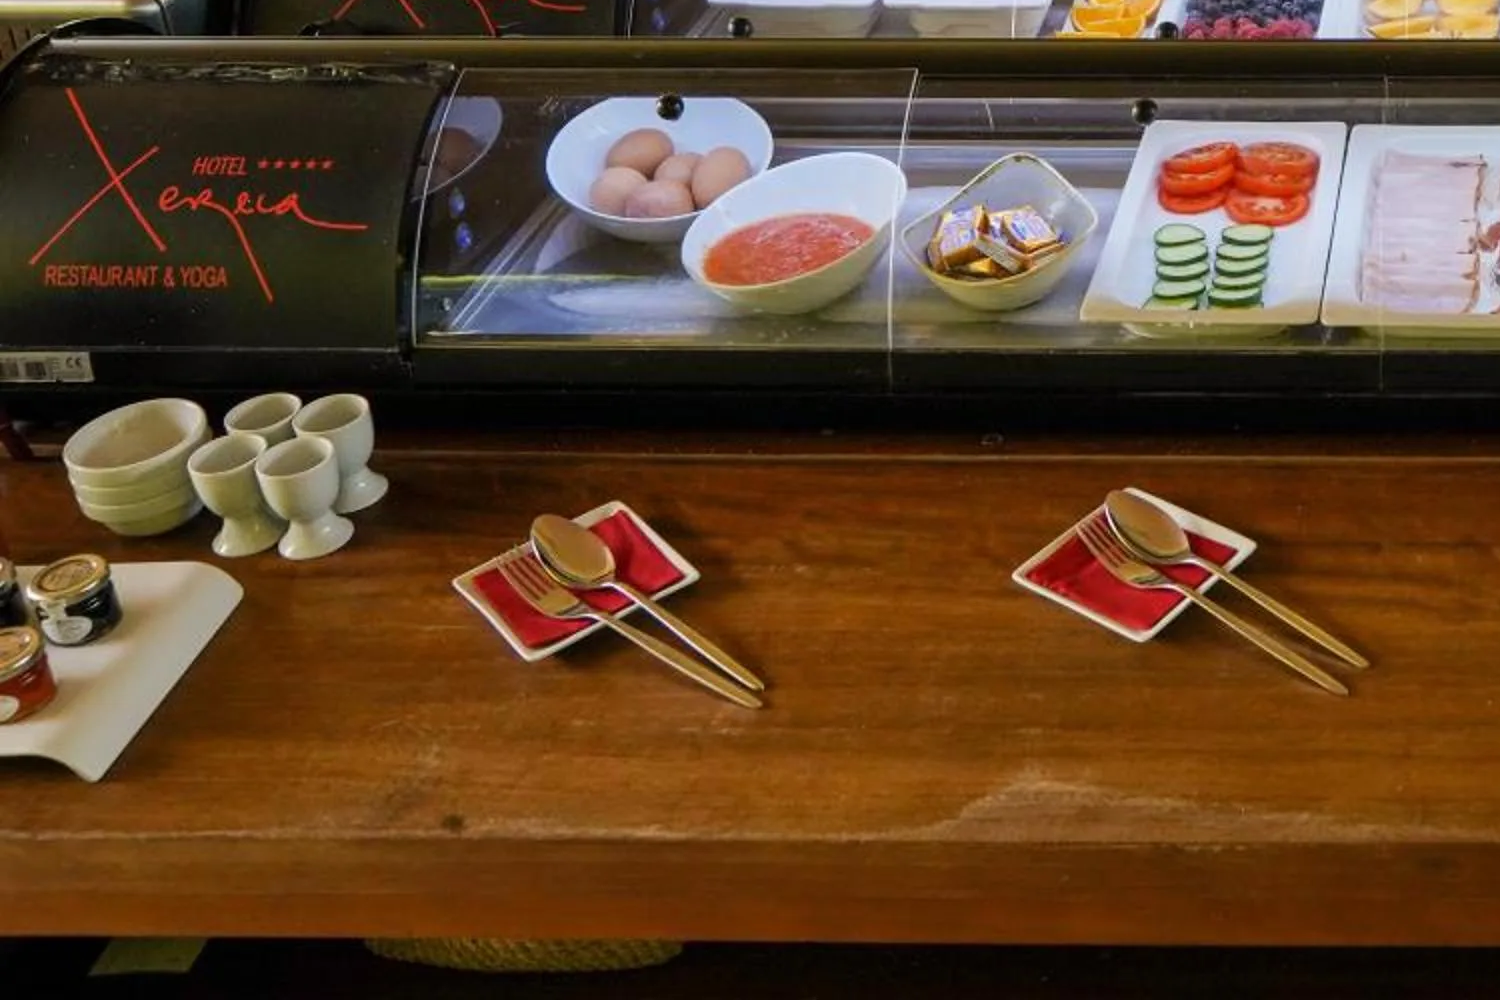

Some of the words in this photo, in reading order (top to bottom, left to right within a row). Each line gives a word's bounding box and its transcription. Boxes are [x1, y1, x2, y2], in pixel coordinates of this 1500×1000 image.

[193, 156, 248, 176] HOTEL
[44, 264, 159, 289] RESTAURANT
[162, 267, 176, 289] &
[179, 265, 229, 288] YOGA
